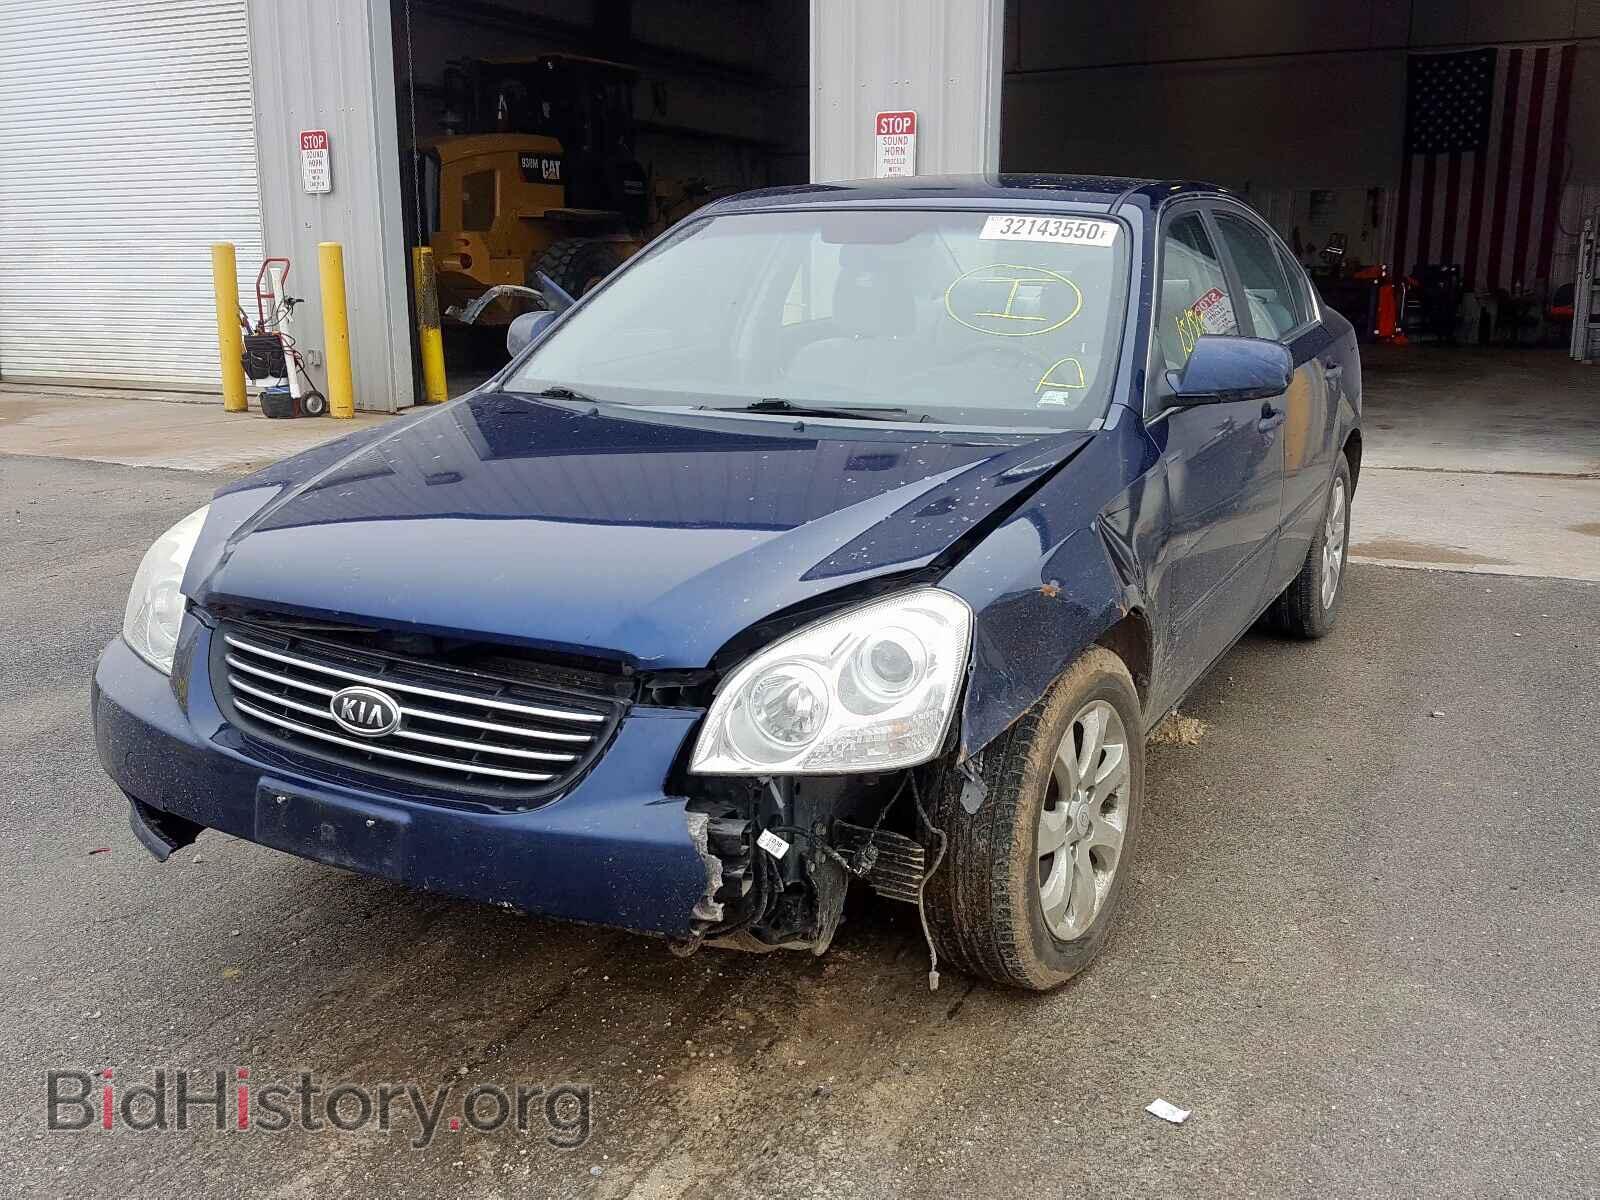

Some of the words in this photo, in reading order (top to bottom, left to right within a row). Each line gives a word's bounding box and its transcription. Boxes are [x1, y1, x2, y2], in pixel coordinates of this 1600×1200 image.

[881, 118, 911, 133] STOP
[304, 136, 324, 149] STOP
[883, 136, 908, 145] SOUND
[885, 146, 906, 156] HORN
[541, 159, 560, 179] CAT
[341, 697, 384, 727] KIA
